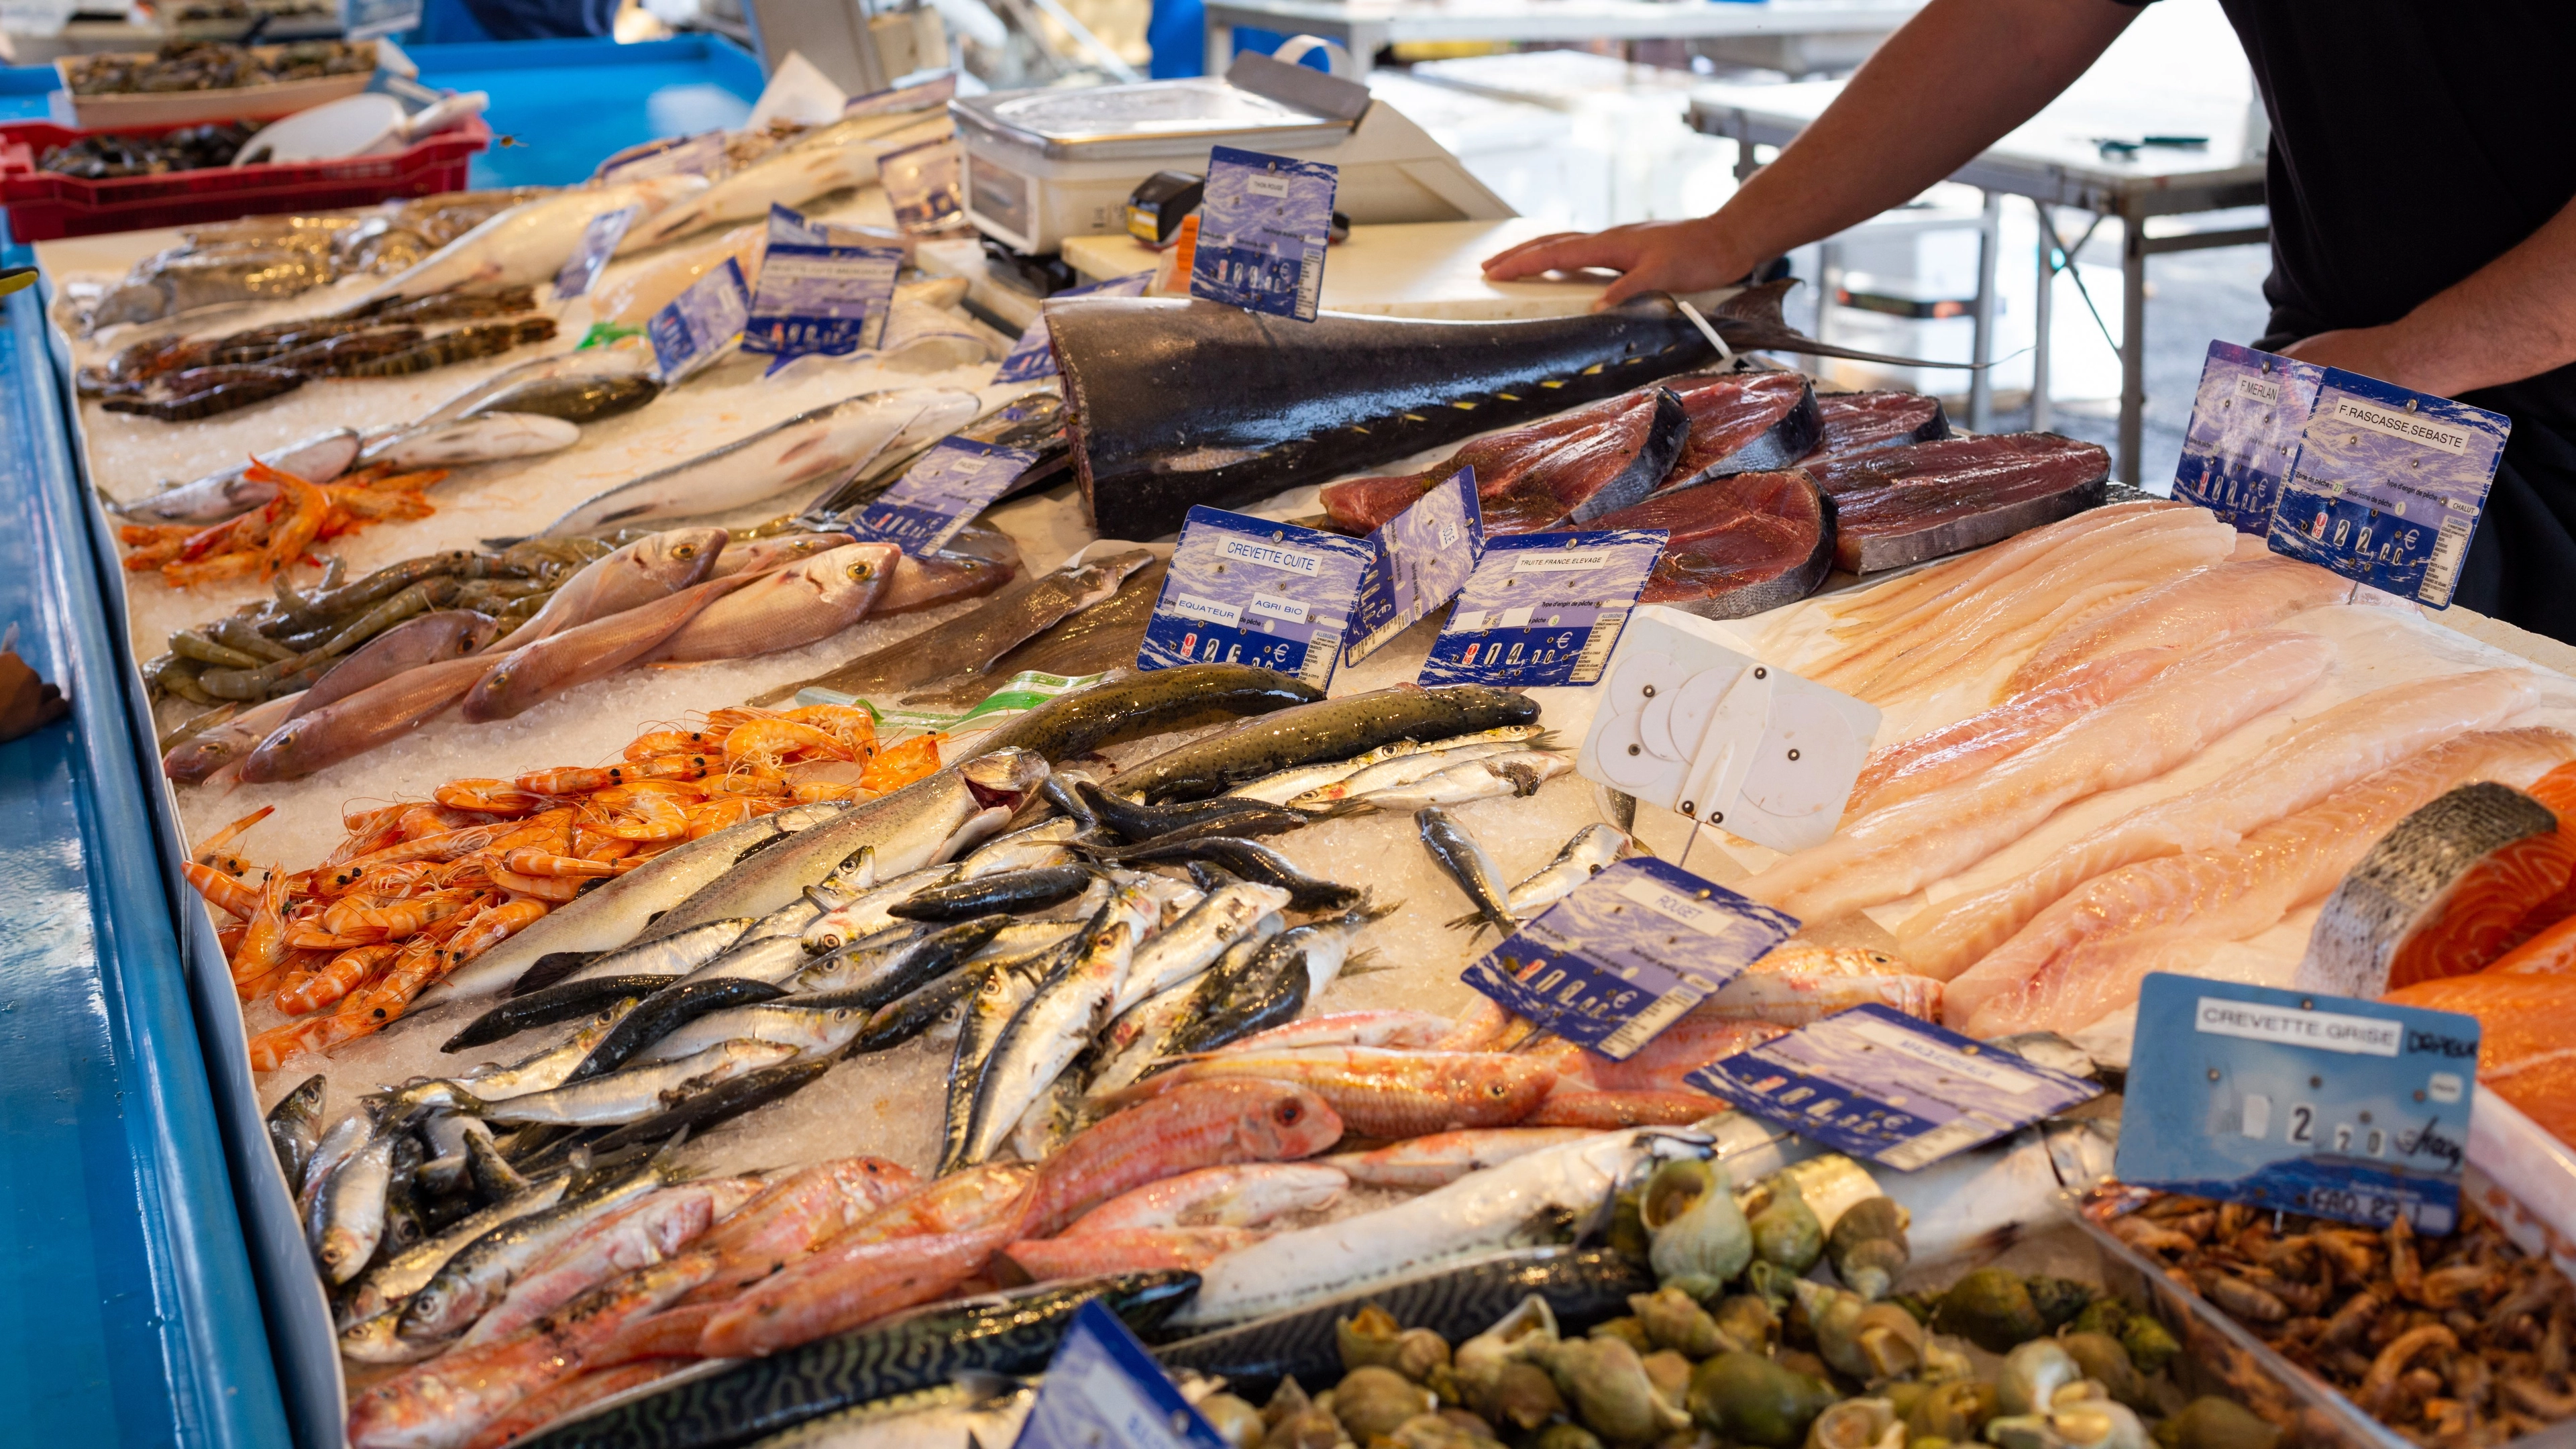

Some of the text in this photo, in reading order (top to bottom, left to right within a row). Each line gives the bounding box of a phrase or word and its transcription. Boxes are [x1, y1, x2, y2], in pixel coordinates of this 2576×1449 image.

[2240, 380, 2277, 401] F.MERLAN
[2339, 405, 2463, 448] F.RASCASSE,SEBASTE
[2257, 478, 2268, 498] €
[2296, 472, 2308, 480] Zone
[2314, 478, 2330, 488] pêche
[2333, 483, 2343, 493] 27
[2346, 488, 2371, 501] Sous-zone
[2377, 498, 2392, 508] pêche
[2386, 479, 2398, 488] Type
[2398, 483, 2416, 495] d'engin
[2422, 491, 2438, 502] pêche
[2453, 502, 2475, 515] CHALUT
[1442, 524, 1454, 545] SOLE
[2312, 526, 2322, 537] kg
[2404, 529, 2420, 550] €
[1227, 541, 1316, 572] CREVETTE CUITE
[1179, 600, 1235, 619] EQUATEUR
[1254, 600, 1303, 616] AGRI BIO
[1377, 604, 1392, 618] €
[1246, 618, 1261, 627] pêche
[1556, 631, 1573, 649] €
[1181, 645, 1191, 657] kg
[1273, 643, 1289, 663] €
[1463, 655, 1471, 664] kg
[1654, 894, 1705, 920] ROUGET
